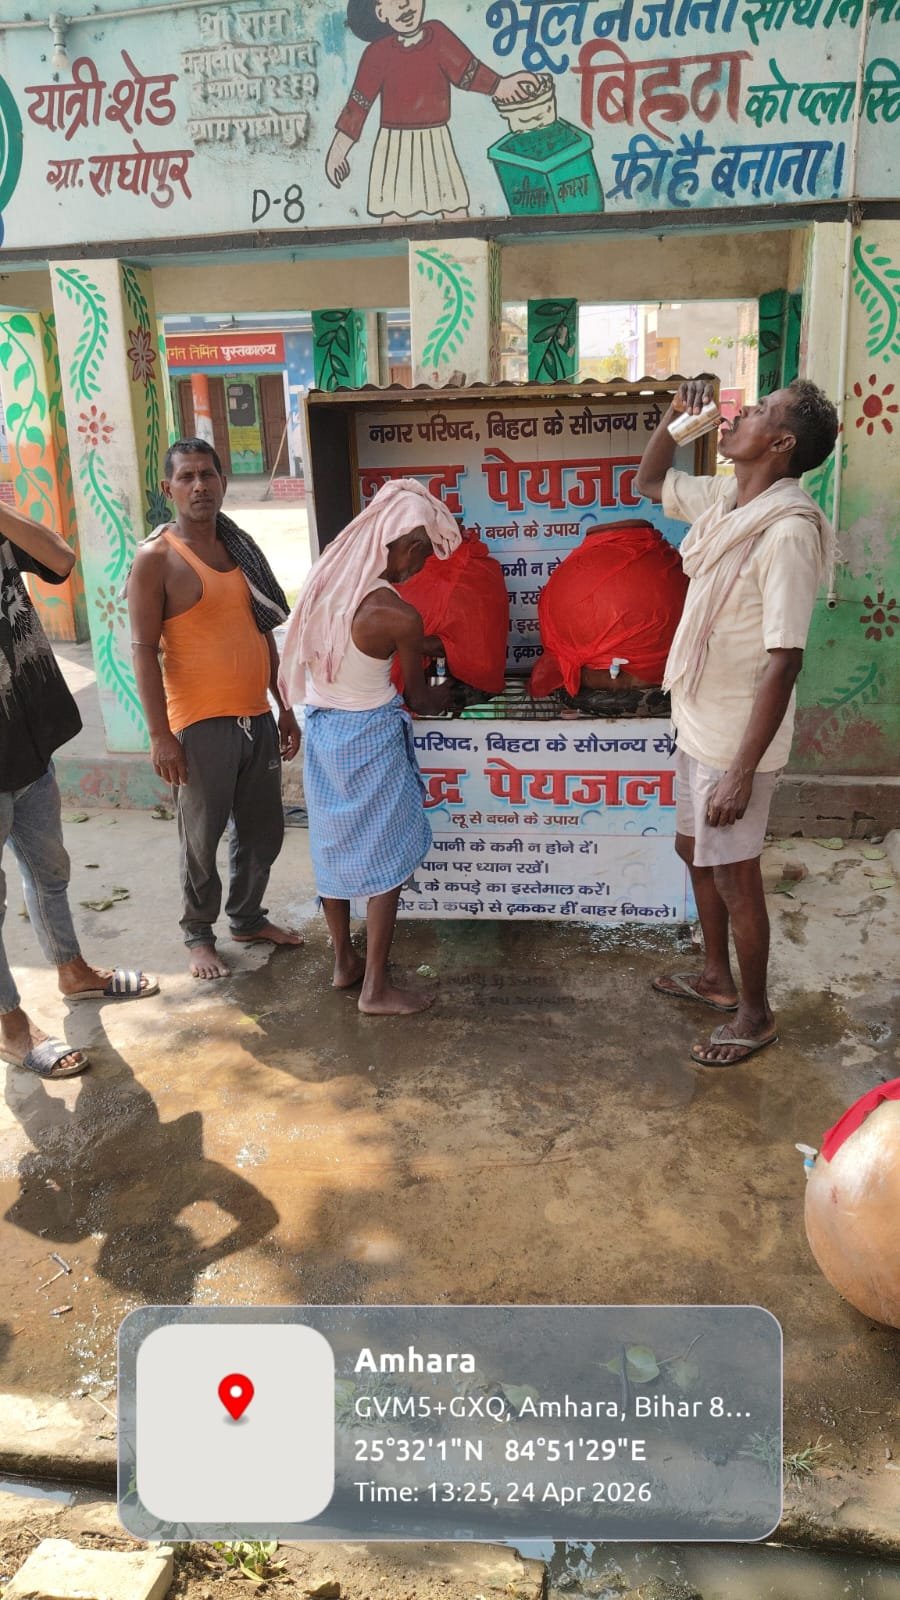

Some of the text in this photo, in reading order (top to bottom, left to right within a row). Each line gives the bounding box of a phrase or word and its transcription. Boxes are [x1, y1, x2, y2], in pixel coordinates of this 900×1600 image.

[486, 0, 598, 74] भूल
[25, 49, 178, 140] यात्री शेड
[744, 58, 800, 128] को
[88, 138, 194, 208] राघोपुर
[667, 128, 716, 207] है
[252, 184, 305, 223] D-8
[220, 343, 277, 361] पुस्तकालय
[369, 423, 414, 444] नगर
[417, 413, 481, 442] परिषद,
[486, 411, 537, 440] बिहटा
[543, 408, 564, 436] के
[569, 406, 637, 436] सौजन्य
[485, 521, 519, 540] बचने
[523, 519, 539, 538] के
[543, 522, 579, 537] उपाय
[530, 563, 543, 576] न
[413, 731, 674, 752] परिषद, बिहटा के सौजन्य से
[484, 757, 677, 806] पेयजल
[469, 811, 482, 824] से
[523, 812, 538, 825] के
[543, 815, 579, 826] उपाय
[433, 837, 465, 852] पानी
[469, 838, 486, 853] के
[490, 838, 523, 853] कमी
[528, 843, 541, 853] न
[545, 840, 574, 855] होने
[452, 862, 472, 873] पर
[476, 863, 512, 874] ध्यान
[424, 878, 440, 893] के
[486, 883, 506, 893] का
[511, 880, 575, 895] इस्तेमाल
[487, 899, 502, 913] से
[581, 904, 617, 916] बाहर
